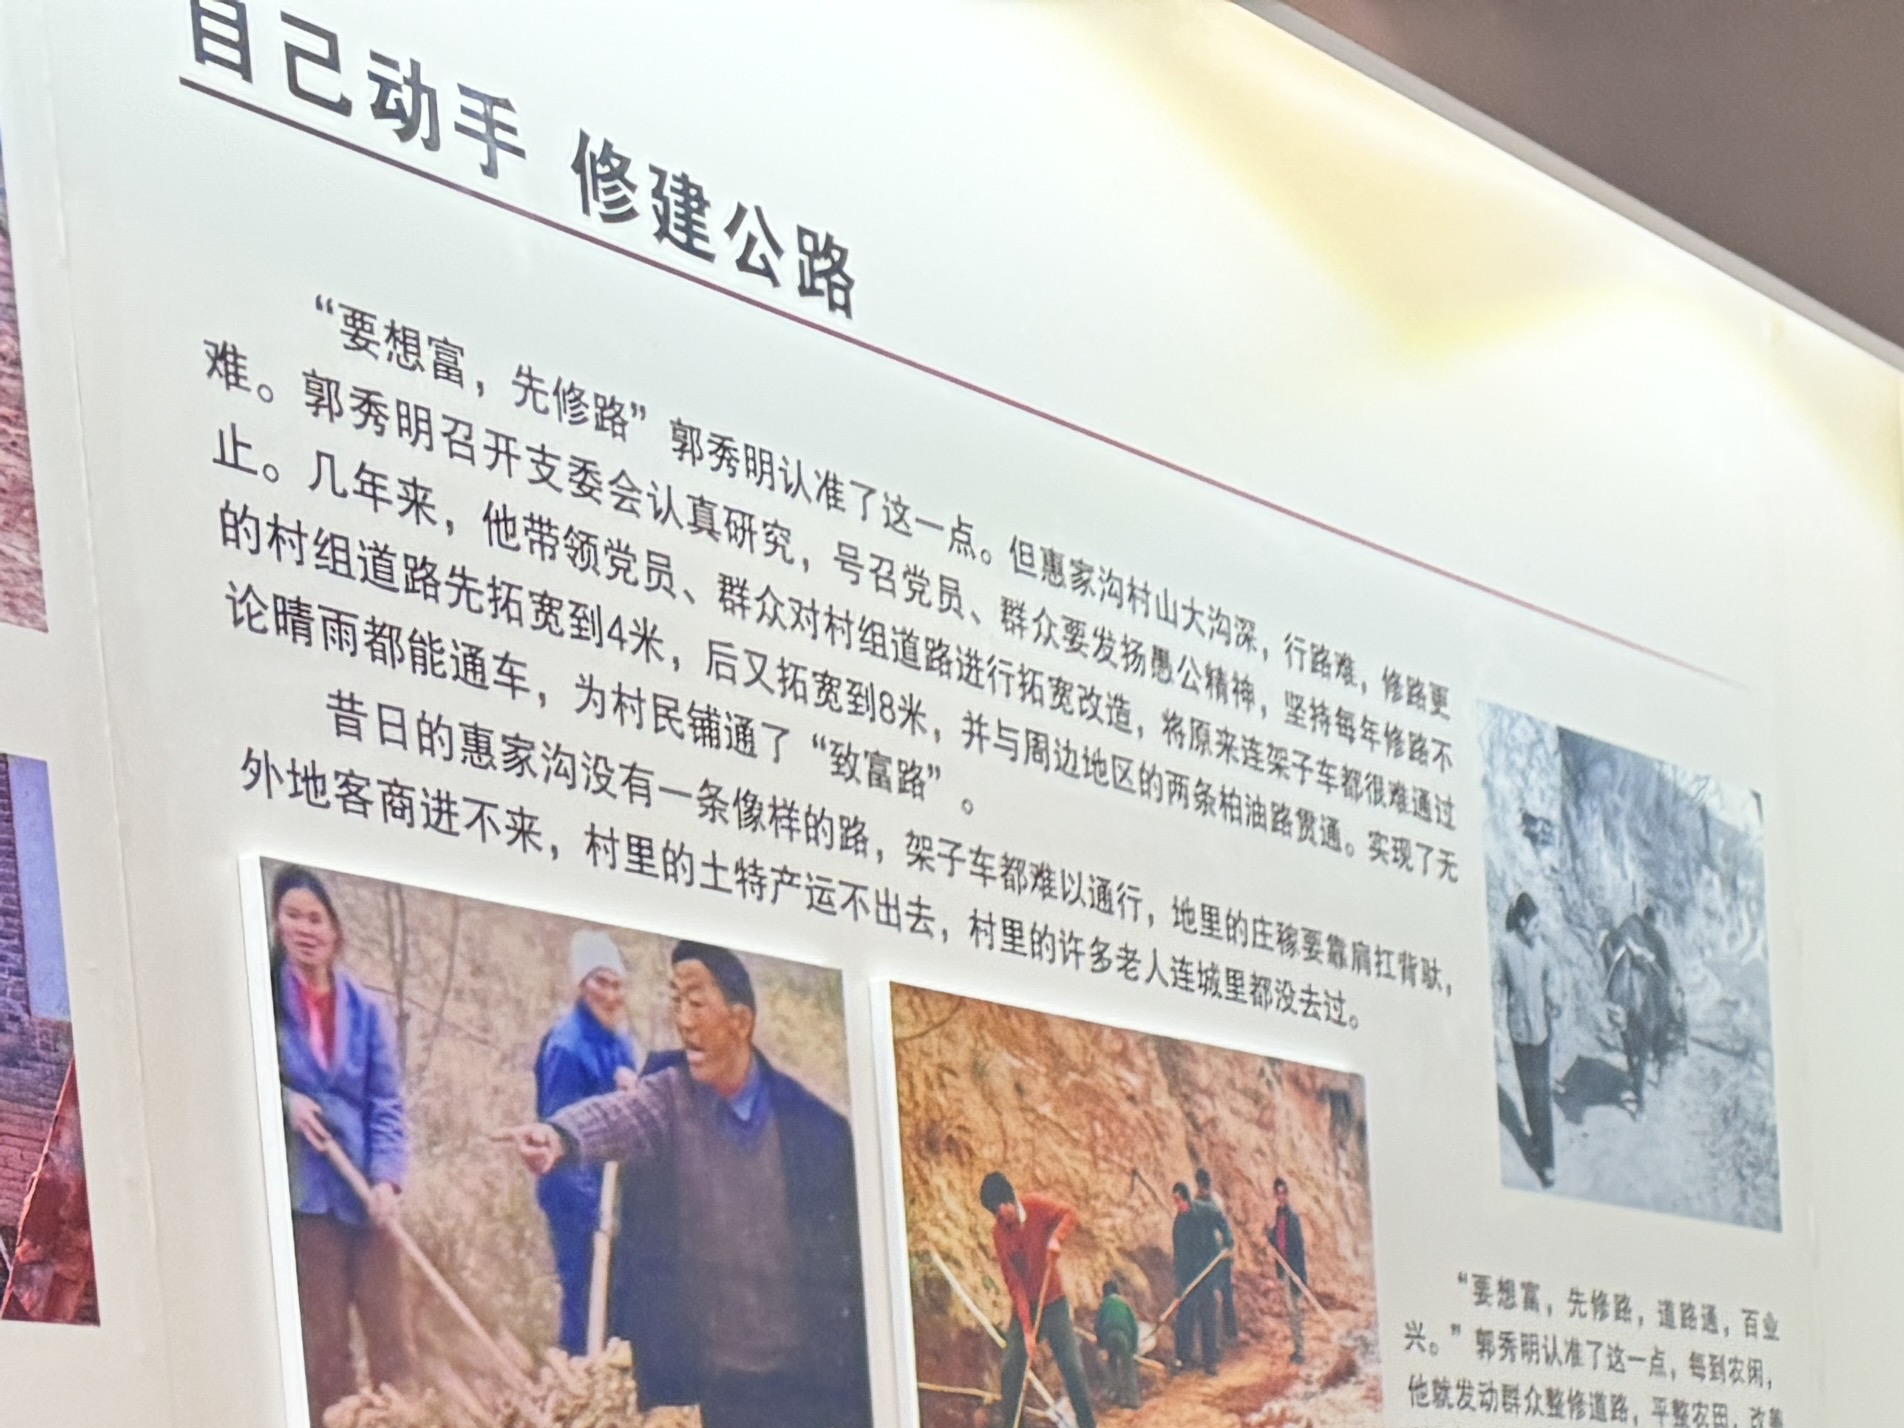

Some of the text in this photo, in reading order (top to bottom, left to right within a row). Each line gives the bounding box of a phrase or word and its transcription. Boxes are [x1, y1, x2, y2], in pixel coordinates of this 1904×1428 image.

[190, 0, 857, 318] 自己动手 修建公路
